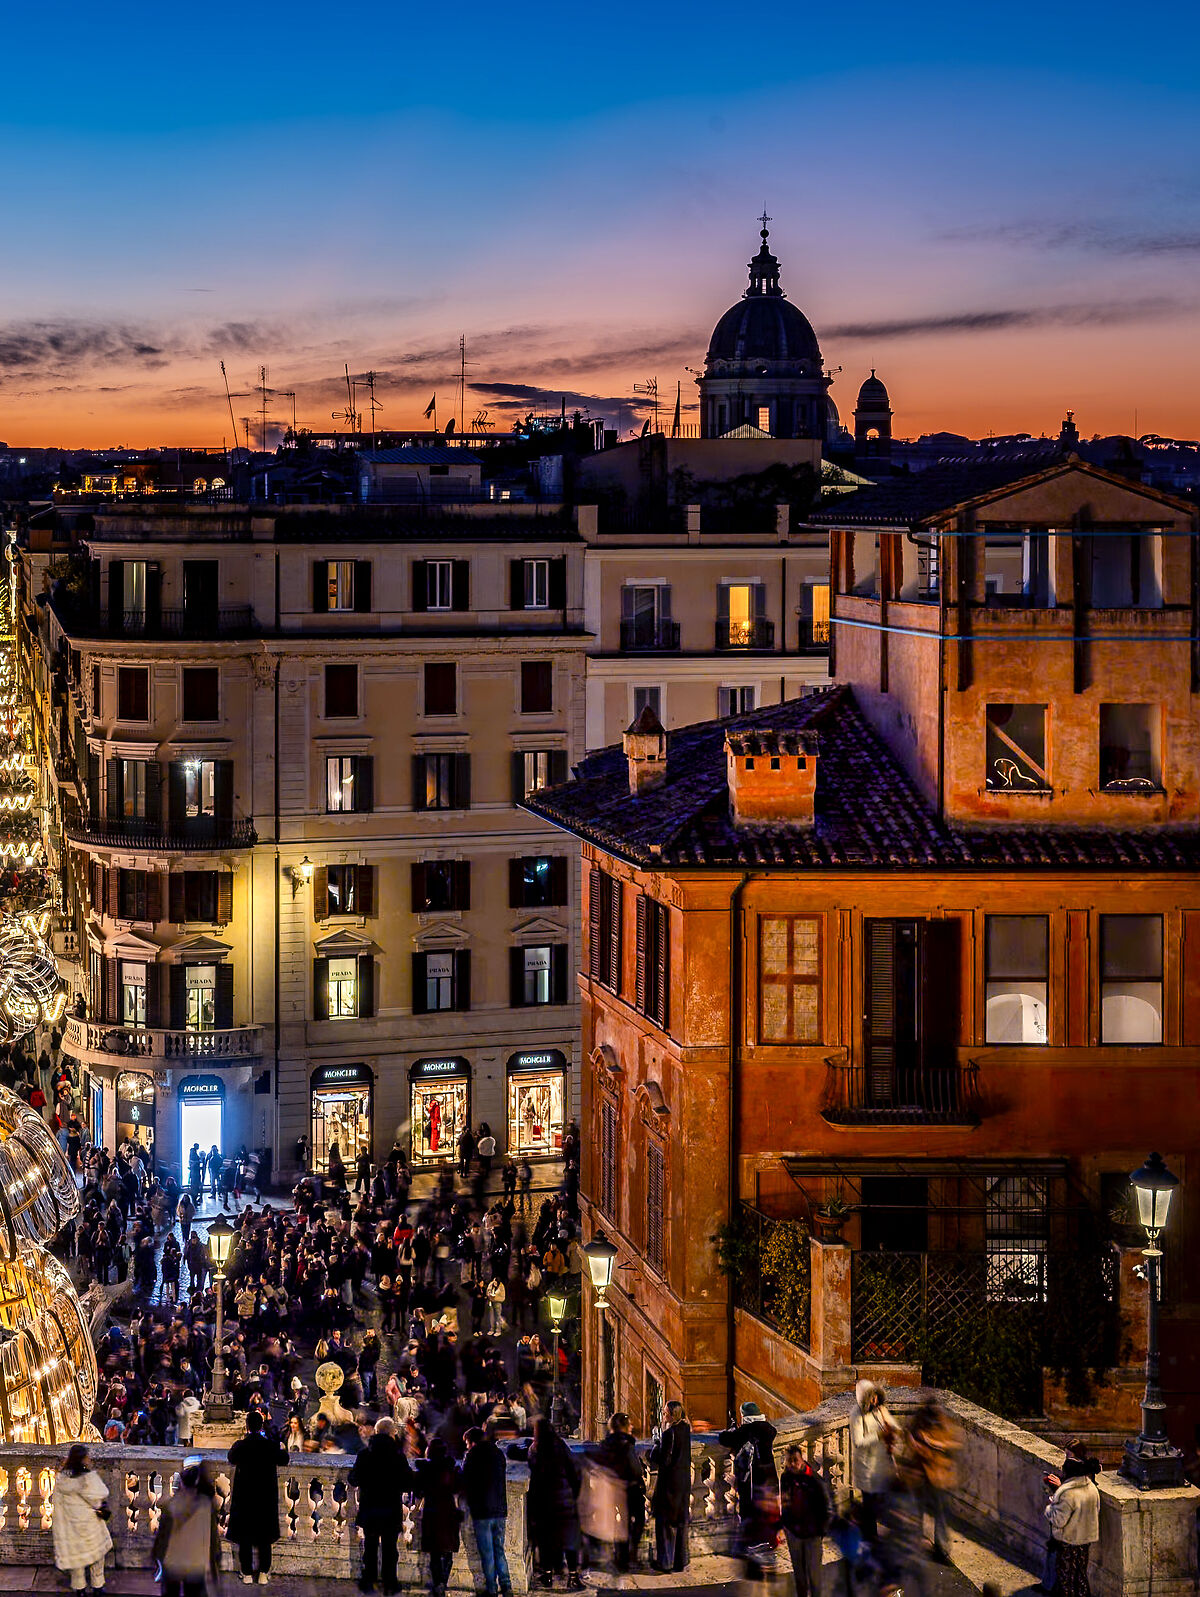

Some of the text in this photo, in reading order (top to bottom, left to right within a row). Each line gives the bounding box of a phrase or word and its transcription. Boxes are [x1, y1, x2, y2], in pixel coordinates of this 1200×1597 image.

[423, 1062, 456, 1072] MONCLER
[324, 1069, 358, 1079] MONCLER
[183, 1084, 219, 1093] MONCLER
